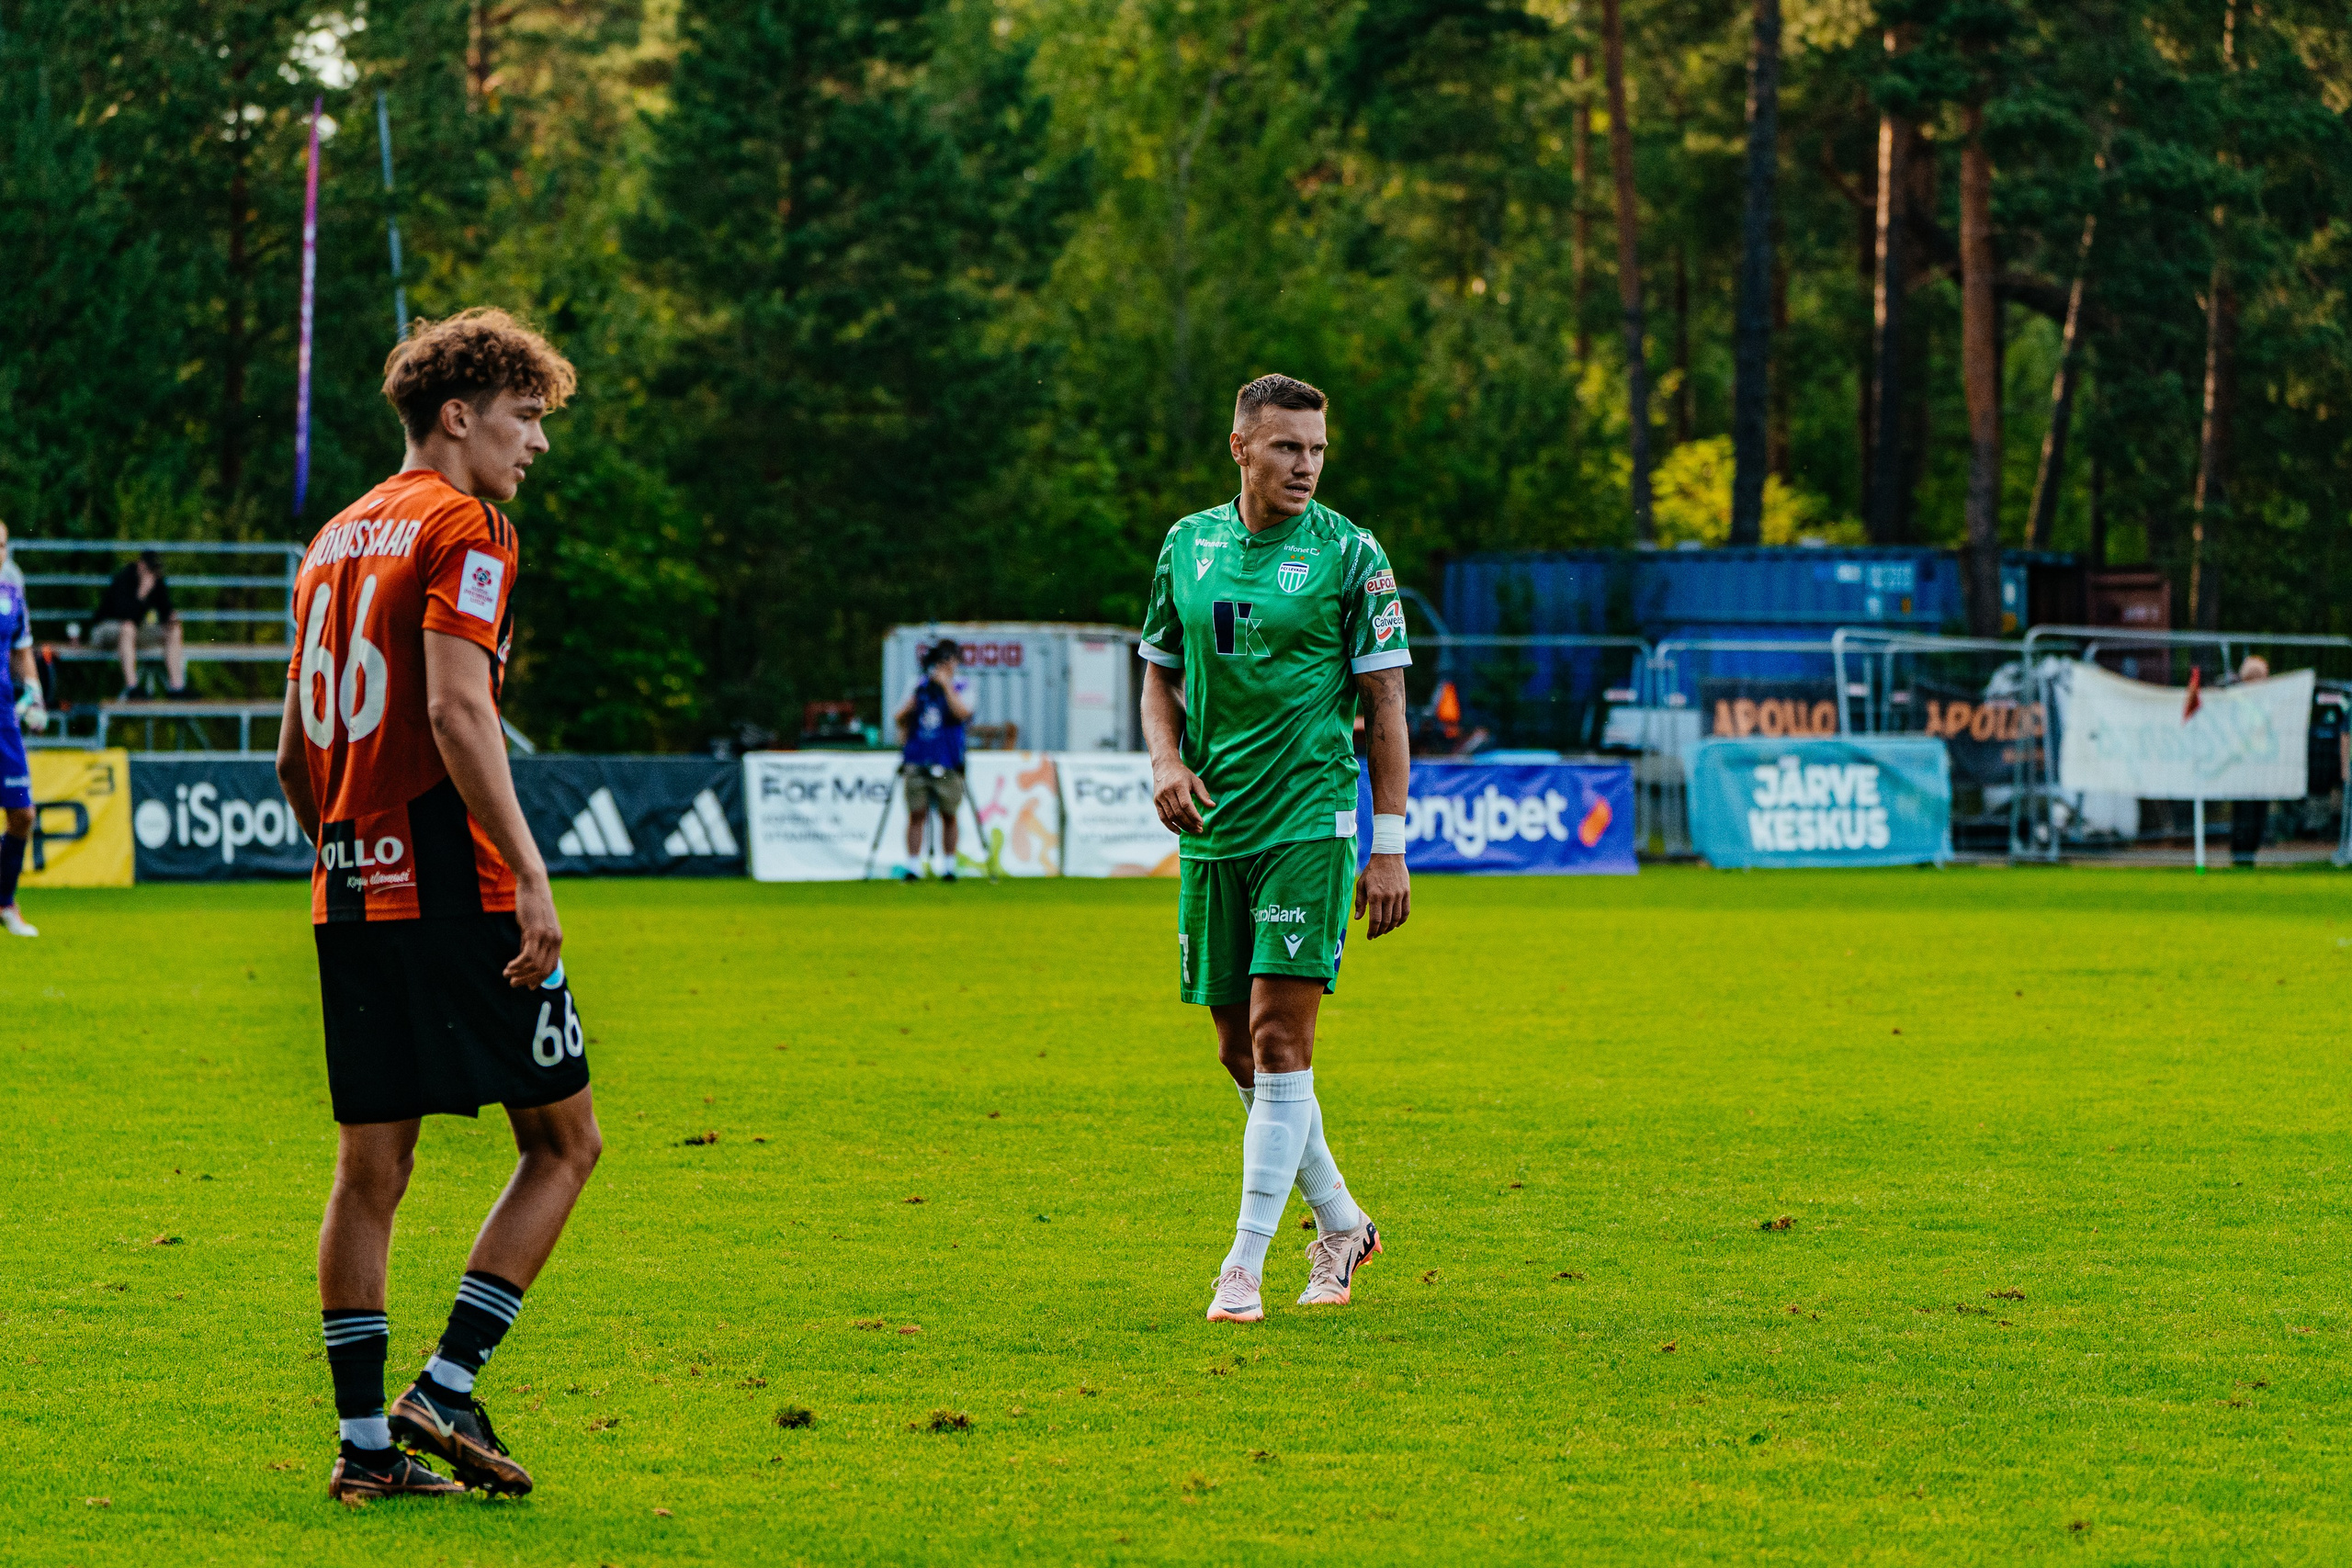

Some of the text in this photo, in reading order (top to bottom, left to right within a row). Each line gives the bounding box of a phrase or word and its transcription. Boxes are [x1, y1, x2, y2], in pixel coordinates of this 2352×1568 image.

[1194, 538, 1229, 548] Winnerz
[1283, 544, 1310, 553] infonet
[1374, 616, 1404, 628] Catwees
[300, 573, 389, 750] 66
[1713, 697, 1838, 739] APOLLO
[761, 776, 824, 803] For
[1753, 755, 1880, 807] JÄRVE
[175, 782, 313, 864] iSpor
[1749, 807, 1890, 852] KESKUS
[321, 836, 404, 871] OLLO
[532, 989, 584, 1067] 66
